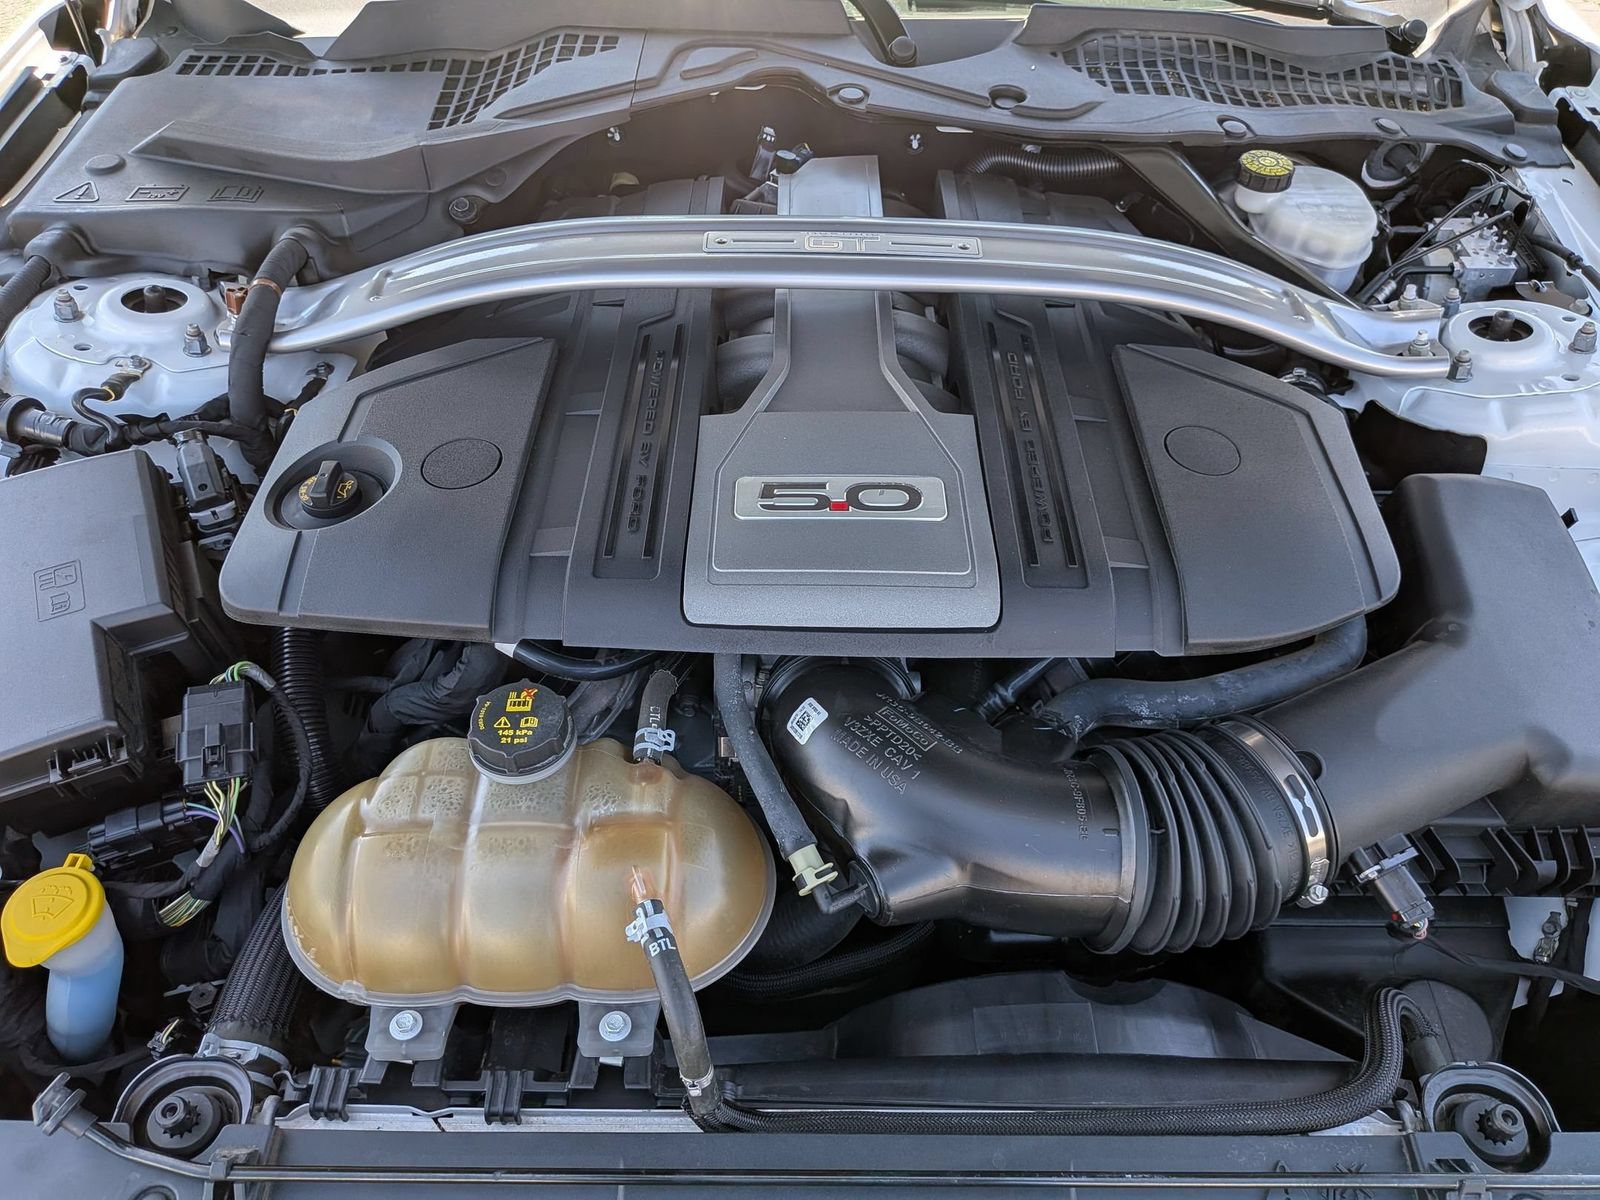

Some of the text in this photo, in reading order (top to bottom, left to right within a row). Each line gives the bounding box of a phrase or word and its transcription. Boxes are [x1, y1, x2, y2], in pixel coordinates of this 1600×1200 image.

[804, 235, 881, 252] GT
[1007, 351, 1026, 400] FORD
[757, 481, 924, 512] 5.0
[881, 709, 930, 746] FoMoCo
[830, 729, 907, 795] MADE IN USA
[884, 746, 914, 771] CAV
[649, 938, 676, 957] BTL
